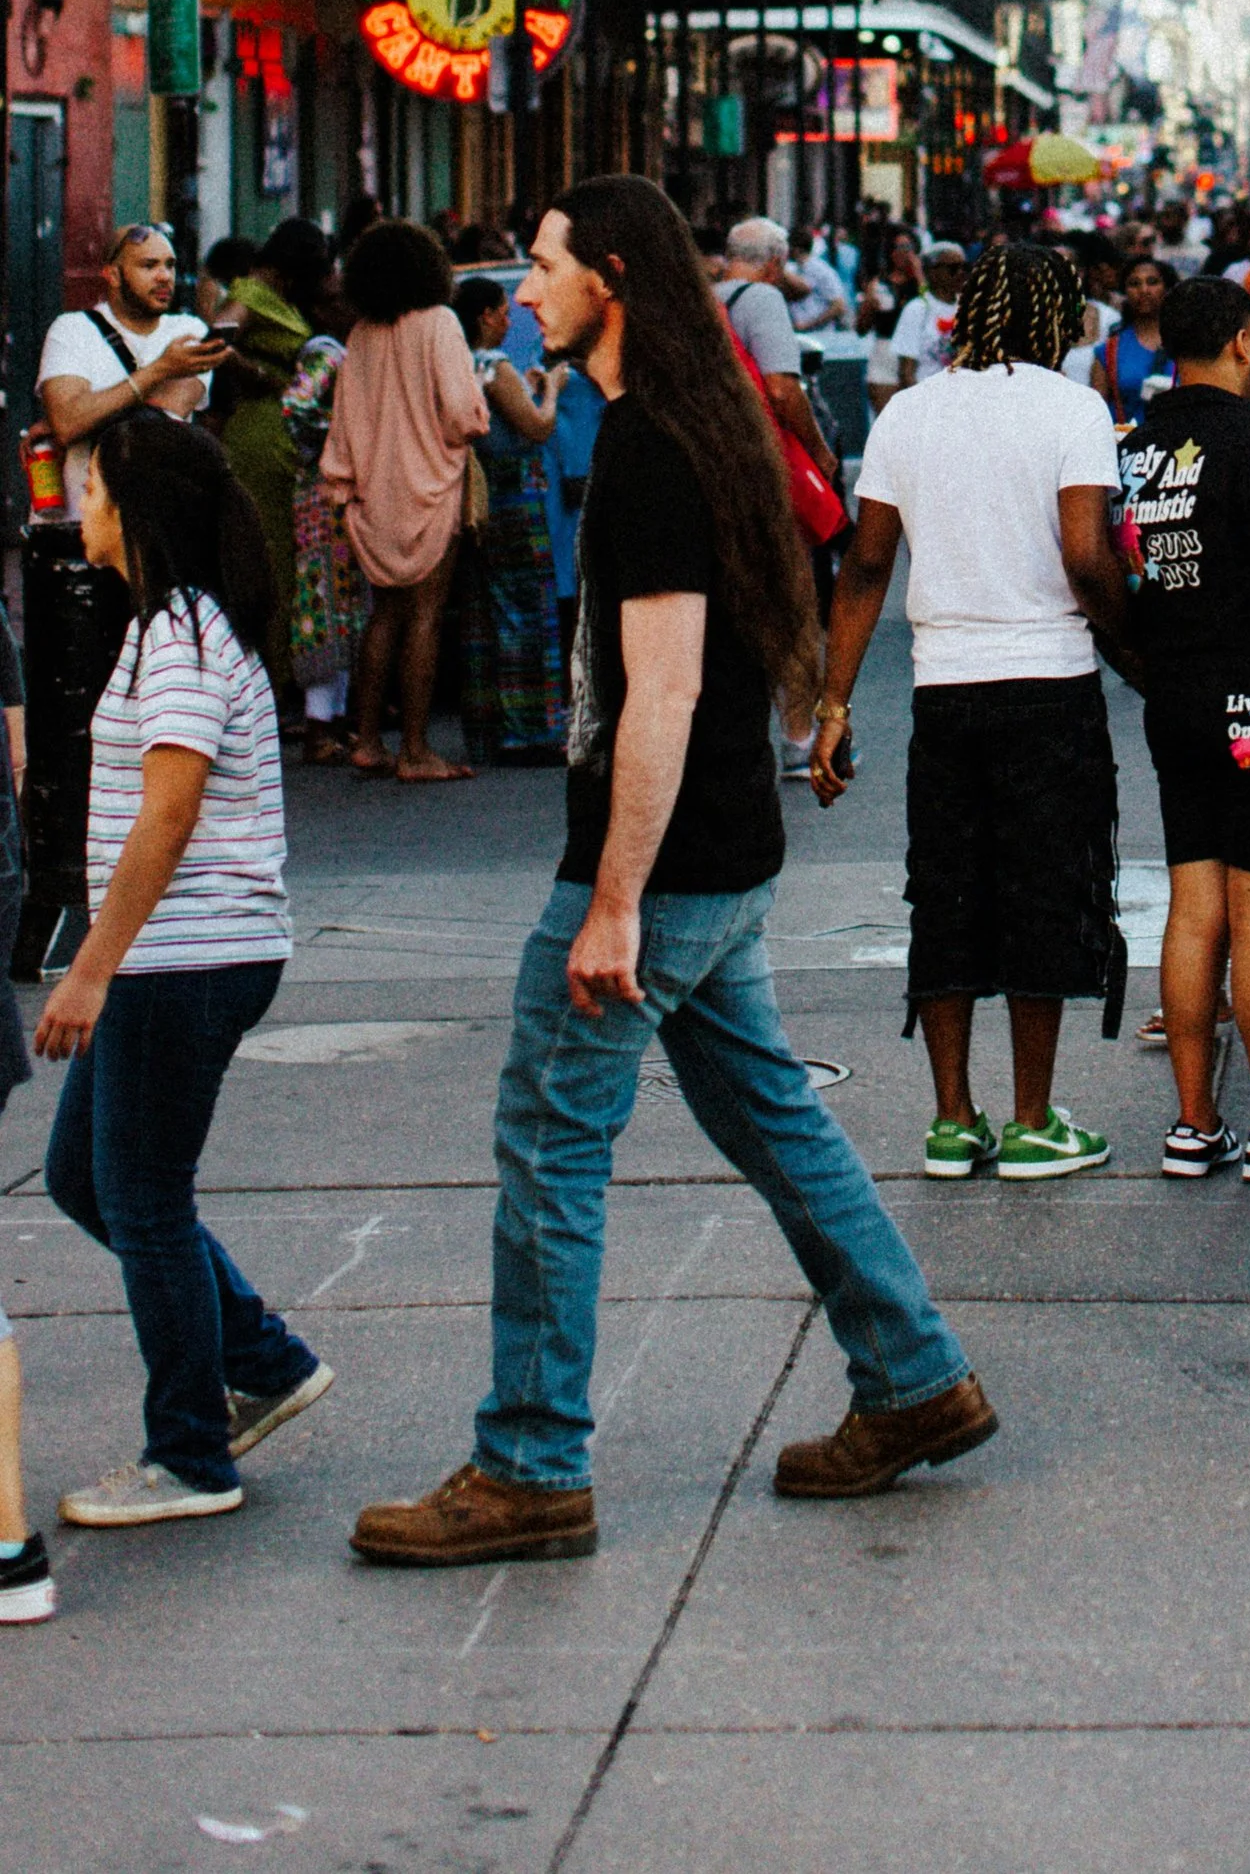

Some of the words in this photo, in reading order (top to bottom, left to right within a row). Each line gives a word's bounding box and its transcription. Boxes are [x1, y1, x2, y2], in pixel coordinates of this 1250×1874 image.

[1119, 444, 1167, 480] ively
[1158, 455, 1205, 489] And
[1147, 529, 1203, 561] SUN
[1160, 560, 1201, 590] NY
